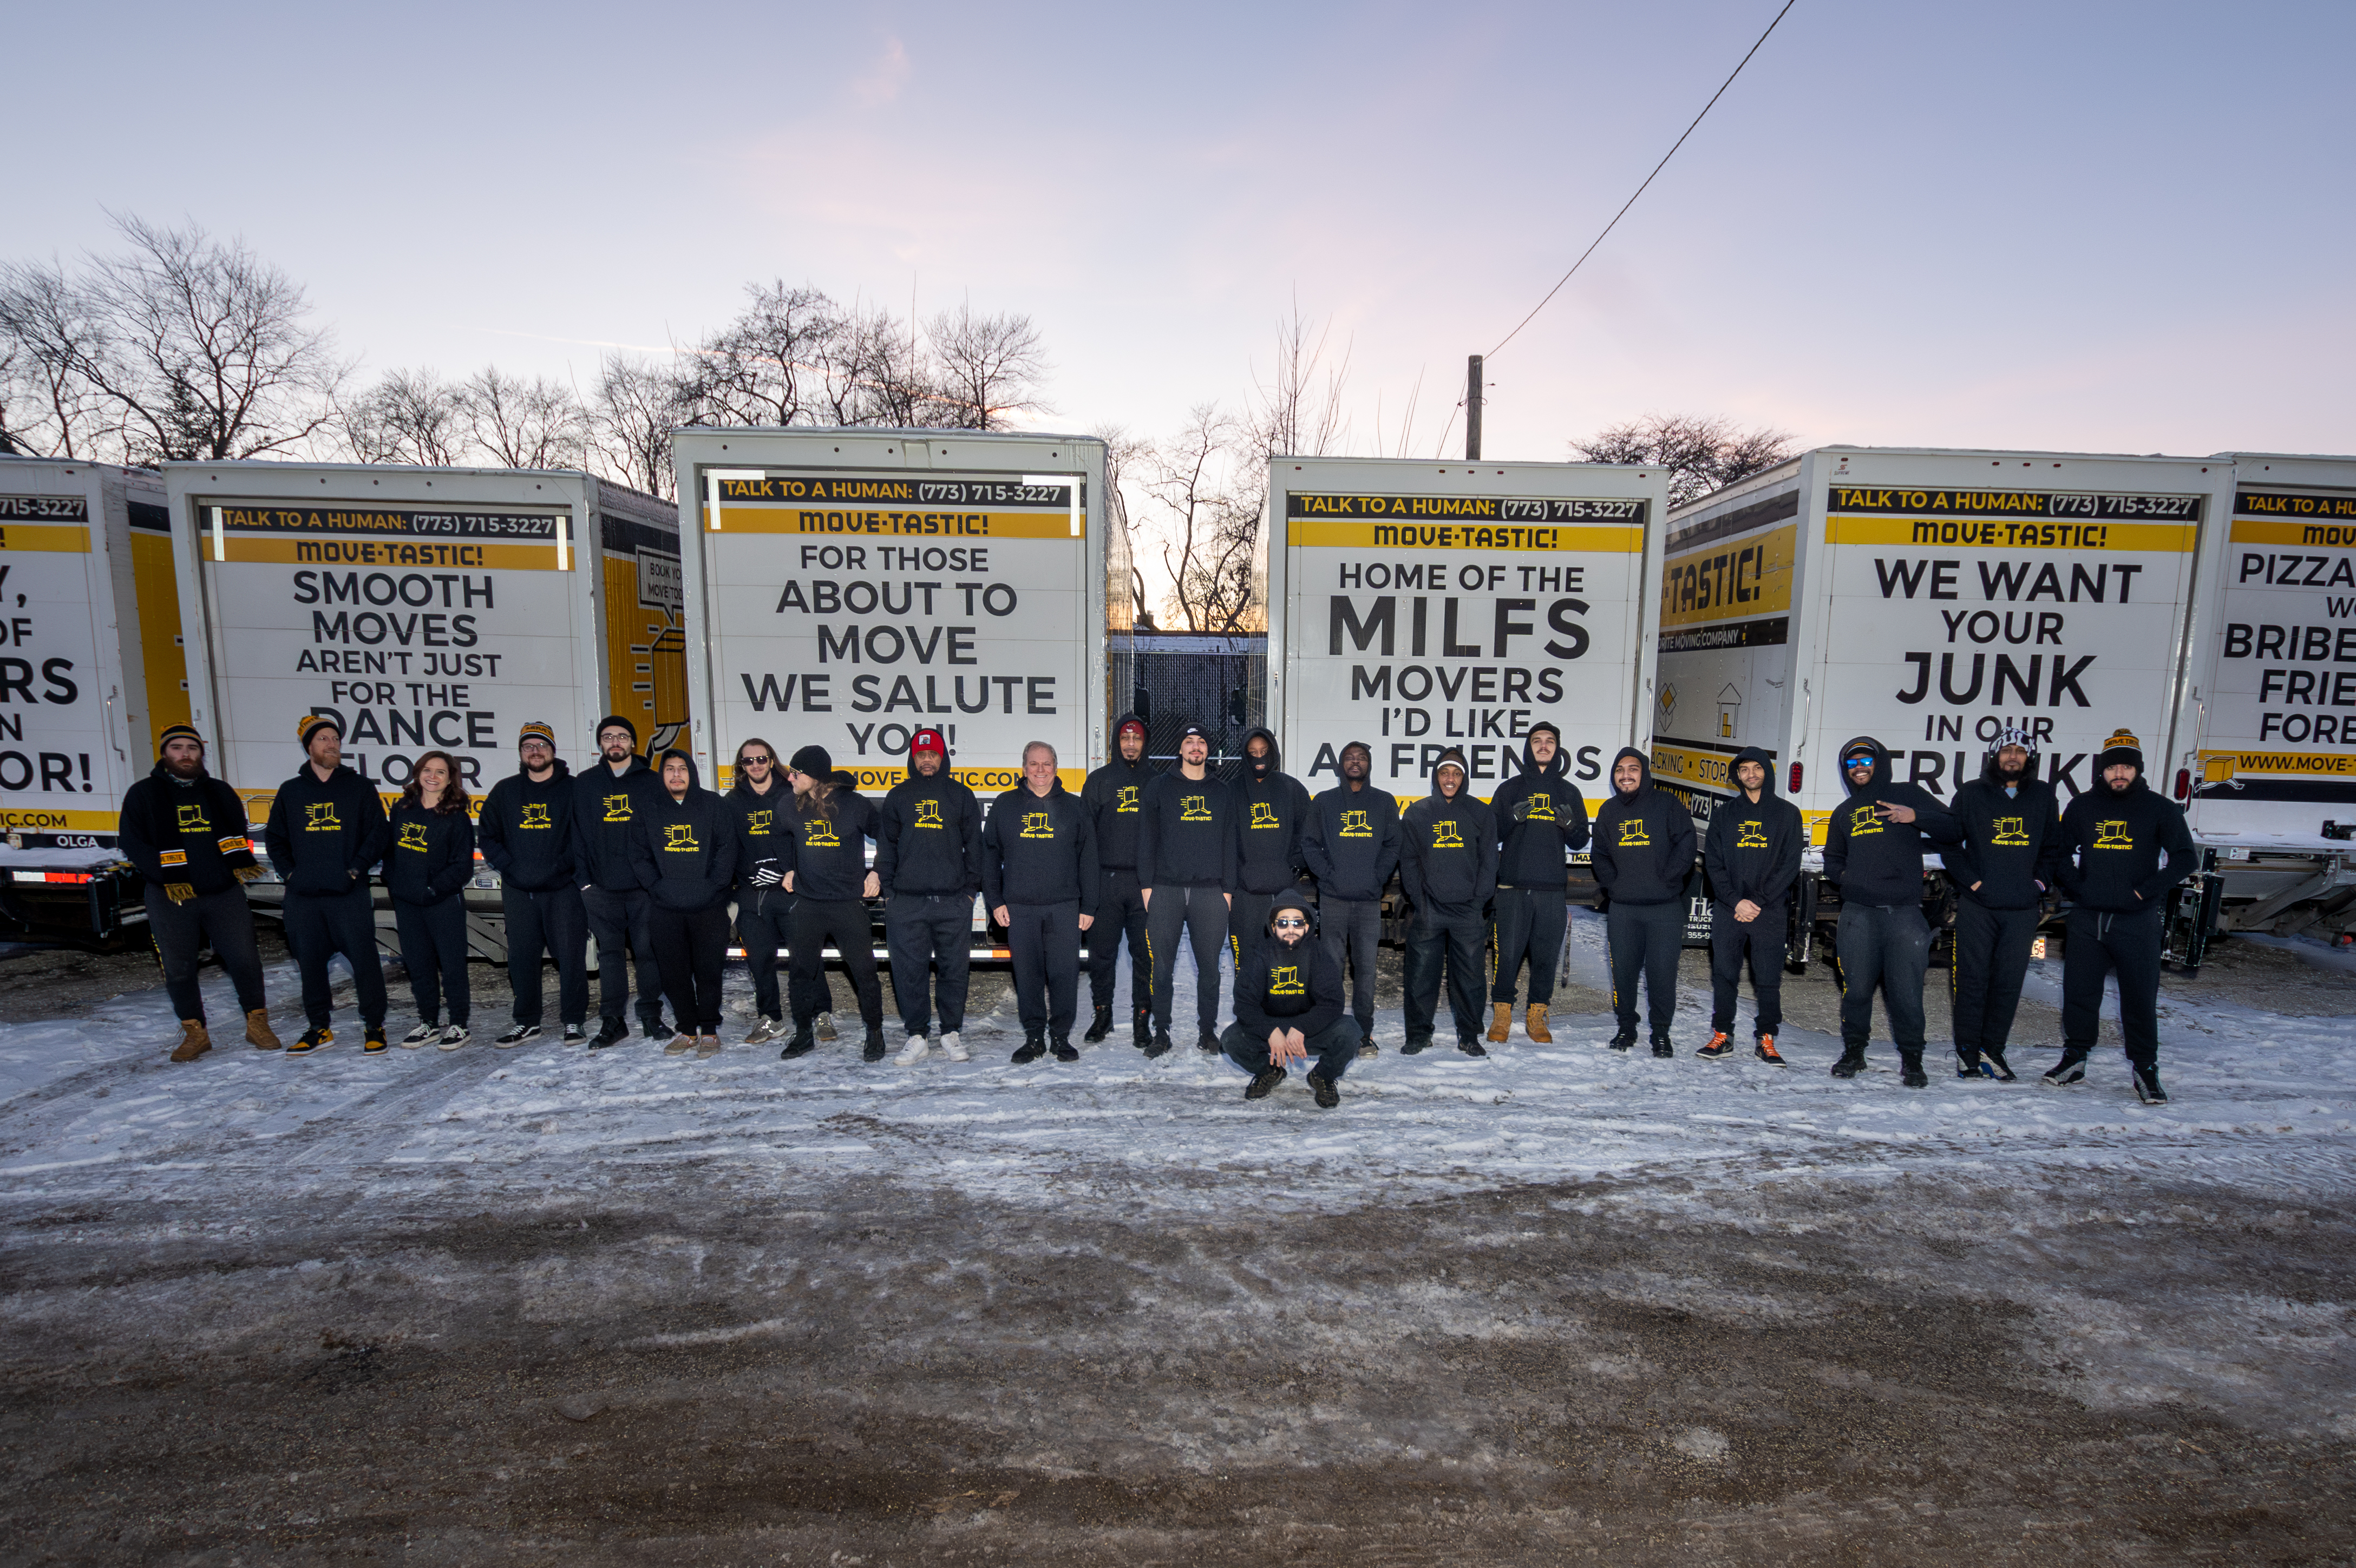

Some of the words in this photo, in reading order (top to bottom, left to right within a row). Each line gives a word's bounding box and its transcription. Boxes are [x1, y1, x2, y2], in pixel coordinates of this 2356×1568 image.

[724, 480, 774, 496] TALK
[779, 481, 805, 497] TO
[812, 482, 827, 497] A
[833, 482, 912, 498] HUMAN:
[919, 484, 967, 502] (773)
[972, 486, 1061, 502] 715-3227
[1838, 489, 1893, 507] TALK
[1898, 491, 1927, 508] TO
[1933, 492, 1949, 508] A
[1955, 493, 2042, 510] HUMAN:
[2049, 494, 2098, 516] (773)
[2106, 496, 2193, 515] 715-3227
[2247, 496, 2287, 511] TALK
[2293, 498, 2314, 512] TO
[2318, 500, 2330, 513] A
[0, 498, 84, 516] 715-3227
[1301, 497, 1352, 513] TALK
[1358, 497, 1387, 513] TO
[1392, 498, 1406, 514] A
[1412, 498, 1495, 515] HUMAN:
[1501, 500, 1548, 520] (773)
[1554, 501, 1637, 518] 715-3227
[222, 510, 271, 526] TALK
[277, 511, 302, 527] TO
[307, 512, 323, 527] A
[329, 513, 407, 530] HUMAN:
[413, 515, 460, 534] (773)
[466, 516, 553, 534] 715-3227
[800, 511, 988, 535] MOVE-TASTIC!
[1913, 522, 2106, 547] MOVE-TASTIC!
[1375, 525, 1557, 548] MOVE-TASTIC!
[297, 541, 483, 566] MOVE-TASTIC!
[801, 545, 866, 570] FOR
[877, 547, 989, 572] THOSE
[650, 562, 670, 578] BOOK
[1340, 563, 1446, 590] HOME
[1459, 565, 1506, 591] OF
[1517, 566, 1584, 592] THE
[1660, 545, 1763, 615] -TASTIC!
[1874, 559, 1960, 599] WE
[1978, 561, 2142, 603] WANT
[2239, 553, 2355, 588] PIZZA
[293, 570, 494, 608] SMOOTH
[648, 583, 669, 598] MOVE
[776, 580, 941, 615] ABOUT
[956, 582, 1017, 616] TO
[2326, 596, 2356, 618] W
[312, 611, 479, 647] MOVES
[1330, 595, 1590, 659] MILFS
[1675, 633, 1701, 649] MOVING
[1702, 629, 1739, 646] COMPANY
[1941, 609, 2064, 645] YOUR
[818, 625, 977, 665] MOVE
[297, 649, 413, 675] AREN'T
[424, 653, 501, 677] JUST
[1352, 665, 1564, 704] MOVERS
[1895, 652, 2098, 707] JUNK
[2259, 669, 2356, 706] FRIE
[331, 681, 396, 705] FOR
[405, 683, 470, 707] THE
[741, 674, 832, 712] WE
[852, 674, 1056, 714] SALUTE
[310, 707, 498, 748] DANCE
[1382, 707, 1430, 736] I'D
[1445, 708, 1531, 738] LIKE
[1926, 715, 1963, 742] IN
[0, 750, 93, 793] OR!
[1691, 792, 1712, 821] (773)
[57, 836, 99, 848] OLGA
